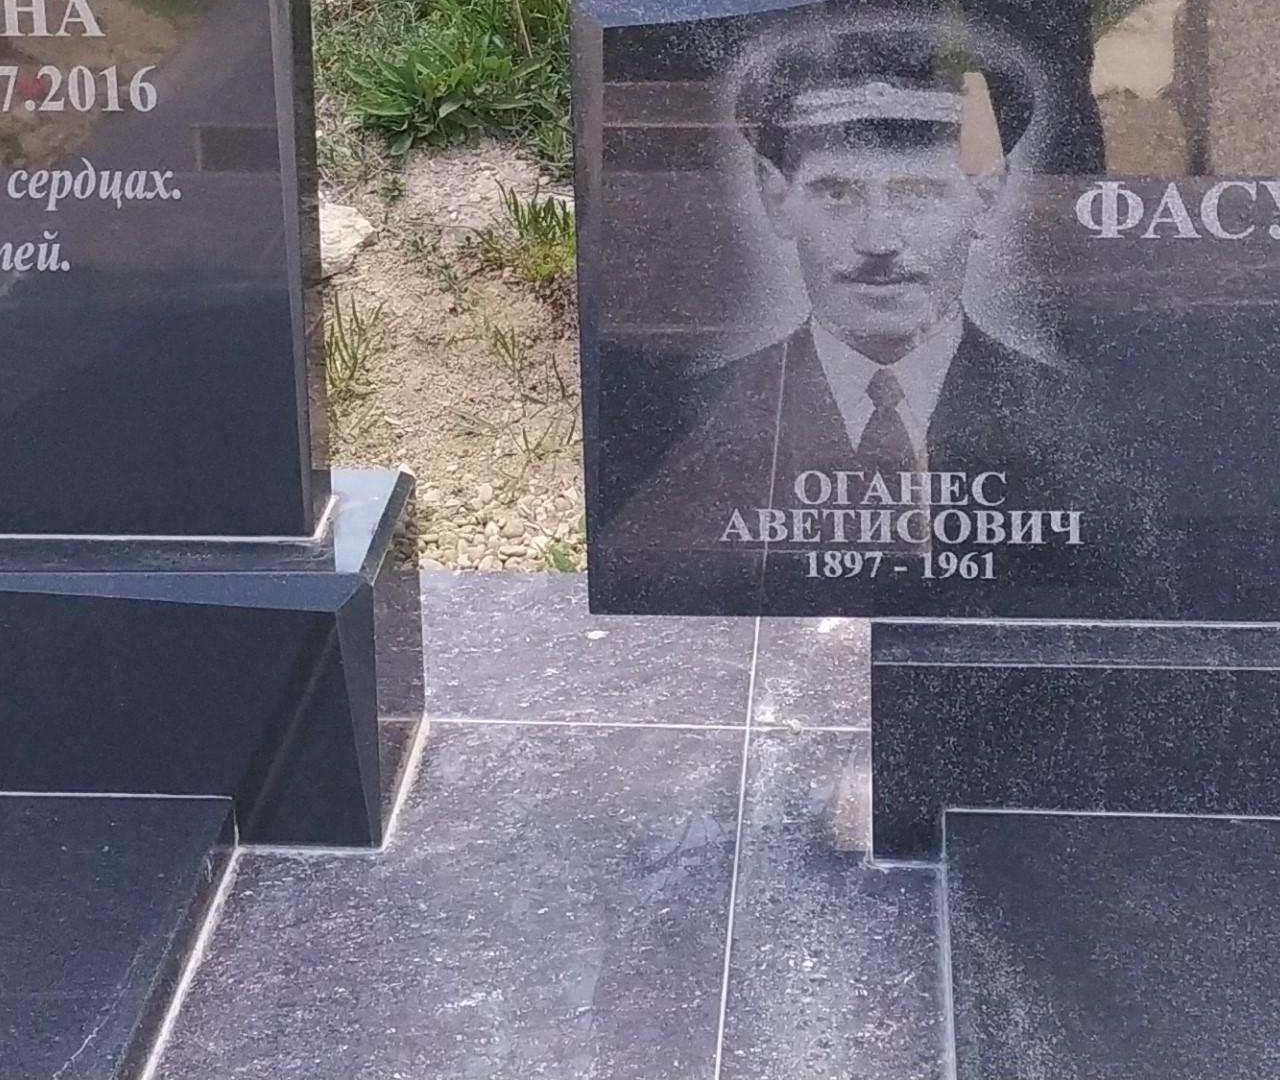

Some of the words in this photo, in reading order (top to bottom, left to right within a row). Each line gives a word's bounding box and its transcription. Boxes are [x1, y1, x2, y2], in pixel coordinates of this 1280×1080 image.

[6, 157, 182, 211] сердцах.
[793, 469, 1008, 506] ОГАНЕС
[719, 508, 1086, 546] АВЕТИСОВИЧ
[805, 550, 884, 579] 1897
[920, 550, 998, 580] 1961
